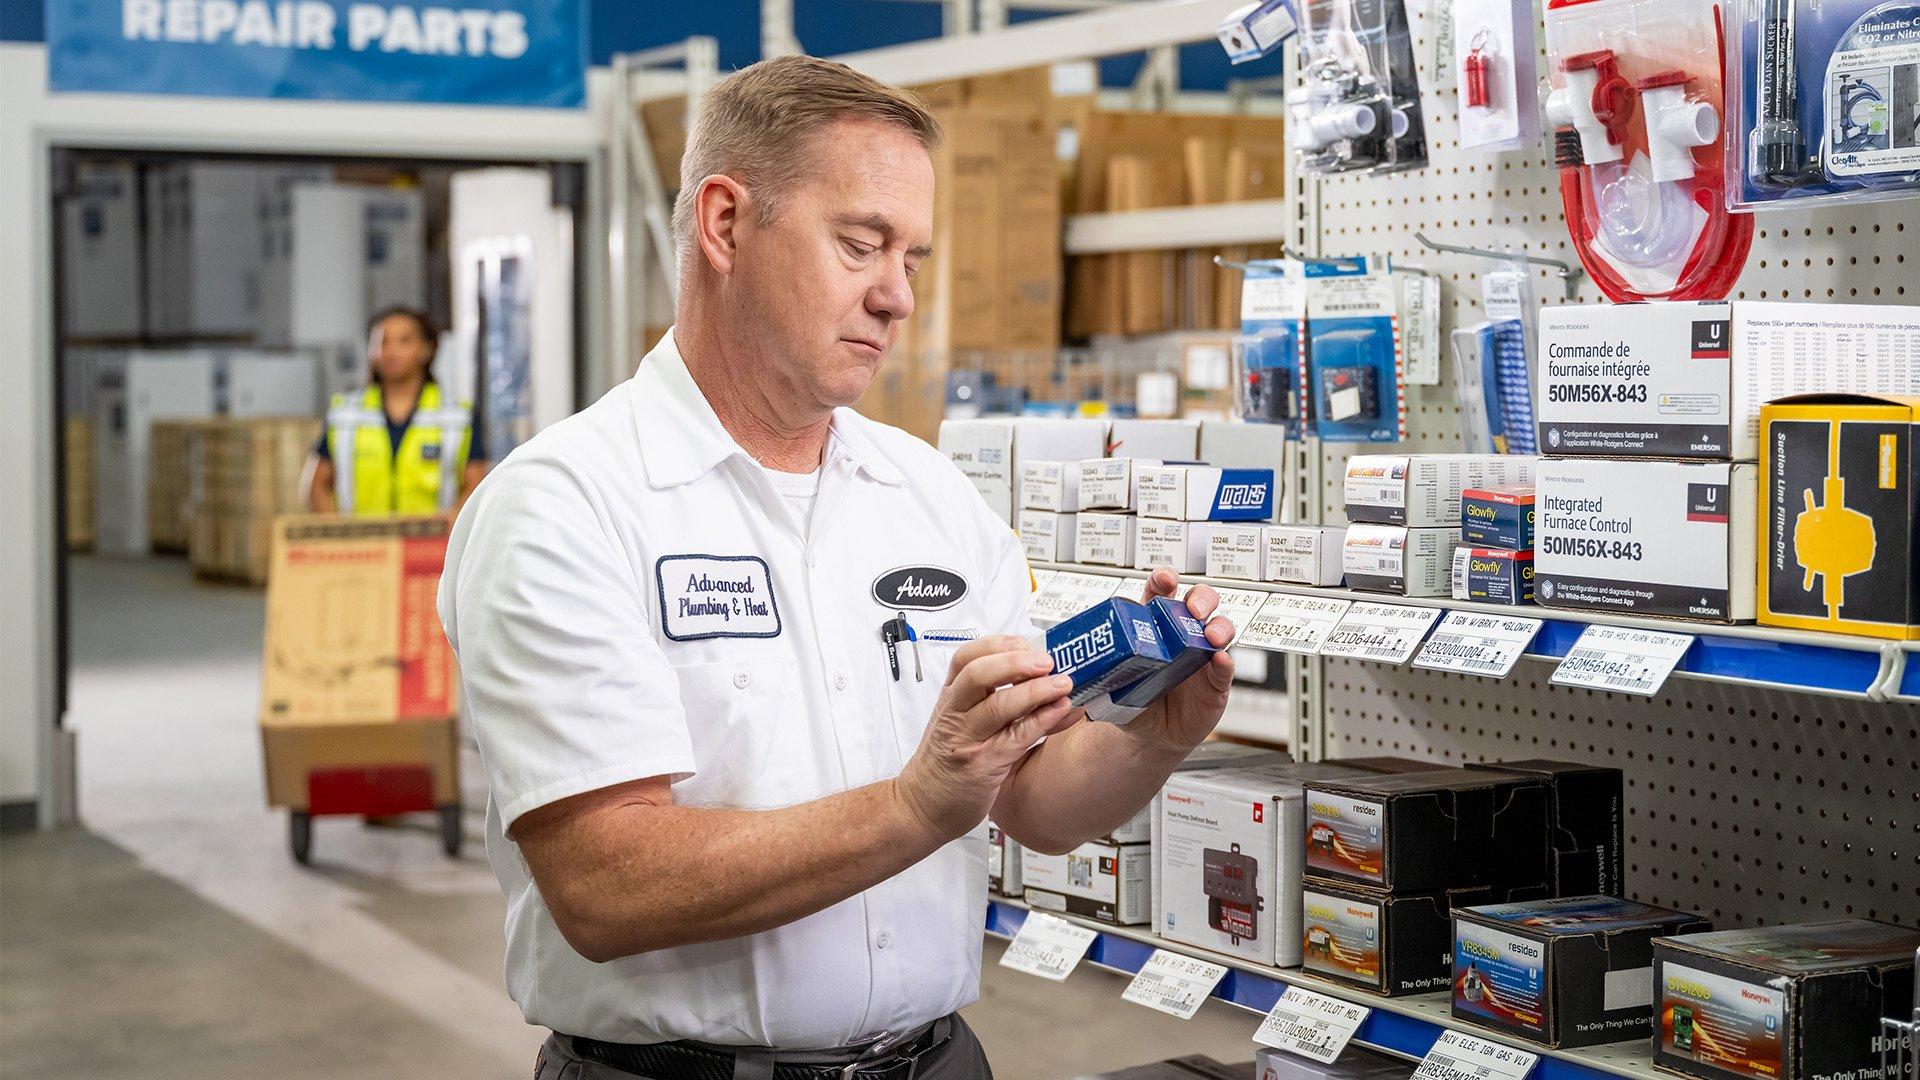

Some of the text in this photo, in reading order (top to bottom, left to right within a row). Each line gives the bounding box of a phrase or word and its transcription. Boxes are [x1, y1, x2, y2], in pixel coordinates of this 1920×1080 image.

[121, 0, 529, 59] REPAIR PARTS
[1858, 20, 1910, 34] Eliminates
[1764, 22, 1776, 60] SUCKER
[1859, 34, 1880, 44] CO2
[1883, 34, 1895, 42] or
[1762, 97, 1771, 117] A/C
[1796, 320, 1819, 328] numbers
[1711, 324, 1720, 340] U
[1549, 341, 1630, 358] Commande de
[1698, 341, 1721, 349] Universel
[1548, 360, 1651, 381] fournaise intégrée
[1548, 384, 1648, 404] 50M56X-843
[1563, 430, 1593, 439] Configuration
[1598, 431, 1624, 440] diagnostics
[1625, 431, 1639, 439] faciles
[1640, 432, 1654, 440] grâce
[1590, 439, 1624, 448] White-Rodgers
[1624, 440, 1644, 448] Connect
[1690, 444, 1721, 452] EMERSON
[1706, 488, 1717, 503] U
[1776, 432, 1786, 571] Suction Line Filter-Drier
[1544, 494, 1603, 516] Integrated
[1694, 504, 1716, 512] Universal
[1466, 504, 1497, 522] Glowfly
[1543, 513, 1587, 532] Furnace
[1589, 515, 1633, 534] Control
[1211, 537, 1229, 545] 33246
[1270, 538, 1287, 546] 33247
[1293, 548, 1313, 556] Sequencer
[1543, 536, 1643, 562] 50M56X-843
[1470, 559, 1501, 576] Glowfly
[686, 573, 755, 593] Advanced
[896, 576, 951, 601] Adam
[1557, 583, 1654, 599] Easy configuration and diagnostics through
[1242, 595, 1261, 607] RLY
[1286, 599, 1345, 613] TIME DELAY RLY
[1566, 592, 1602, 604] White-Rodgers
[1601, 595, 1623, 605] Connect
[1623, 597, 1635, 607] App
[679, 598, 768, 621] Plumbing & Heat
[1366, 608, 1380, 616] HOT
[1380, 609, 1398, 618] SURF
[1399, 610, 1416, 619] FURN
[1417, 612, 1433, 620] IGN
[1689, 606, 1720, 616] EMERSON
[1451, 615, 1468, 626] IGN
[1469, 617, 1500, 629] W/BRKT
[1327, 631, 1386, 648] W21D6444
[1584, 627, 1687, 648] SGL STG HSI FURN CONT KIT
[1352, 804, 1376, 817] resideo
[1177, 812, 1190, 821] Pump
[1190, 815, 1205, 823] Defrost
[1205, 818, 1218, 826] Board
[1346, 907, 1374, 918] Honeywell
[1508, 941, 1538, 958] resideo
[1169, 959, 1186, 971] H/P
[1185, 962, 1203, 976] DEF
[1202, 967, 1220, 980] BRD
[1401, 976, 1452, 989] The Only Thing
[1282, 990, 1303, 1003] UNIV
[1319, 999, 1345, 1016] PILOT
[1344, 1008, 1361, 1022] MDL
[1576, 1024, 1589, 1032] The
[1589, 1022, 1605, 1031] Only
[1606, 1020, 1623, 1029] Thing
[1623, 1018, 1635, 1026] We
[1438, 1033, 1532, 1067] UNIV ELEC IGN GAS VLV
